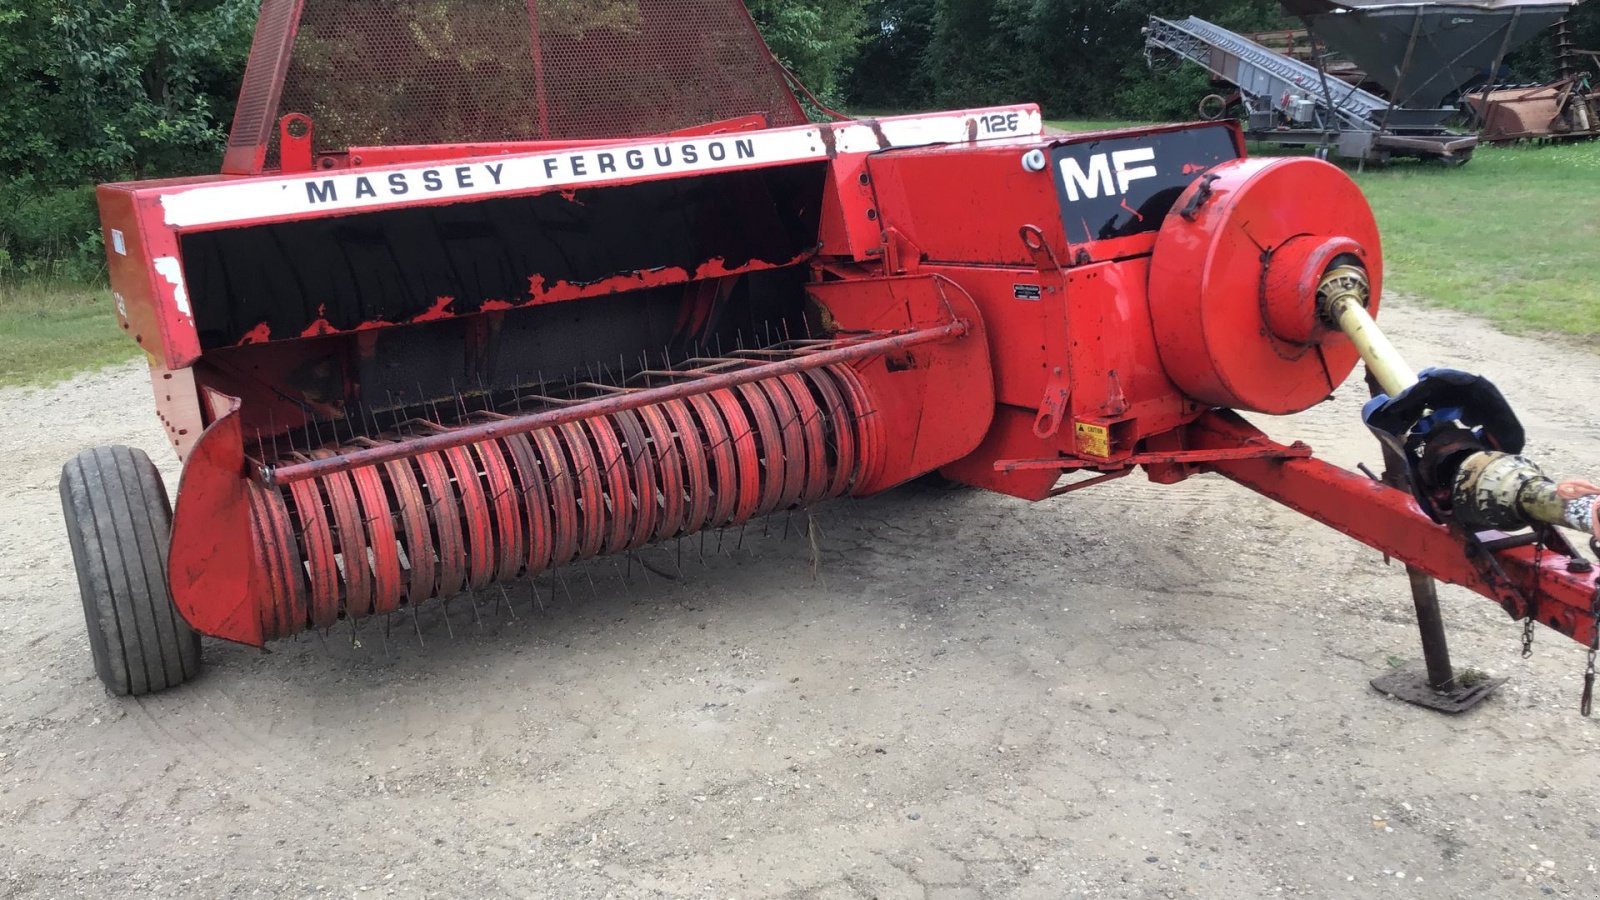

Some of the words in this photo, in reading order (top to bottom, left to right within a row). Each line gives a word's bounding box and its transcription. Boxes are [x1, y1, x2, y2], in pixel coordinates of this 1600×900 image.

[305, 163, 504, 204] MASSEY
[543, 139, 755, 179] FERGUSON
[1059, 147, 1157, 202] MF
